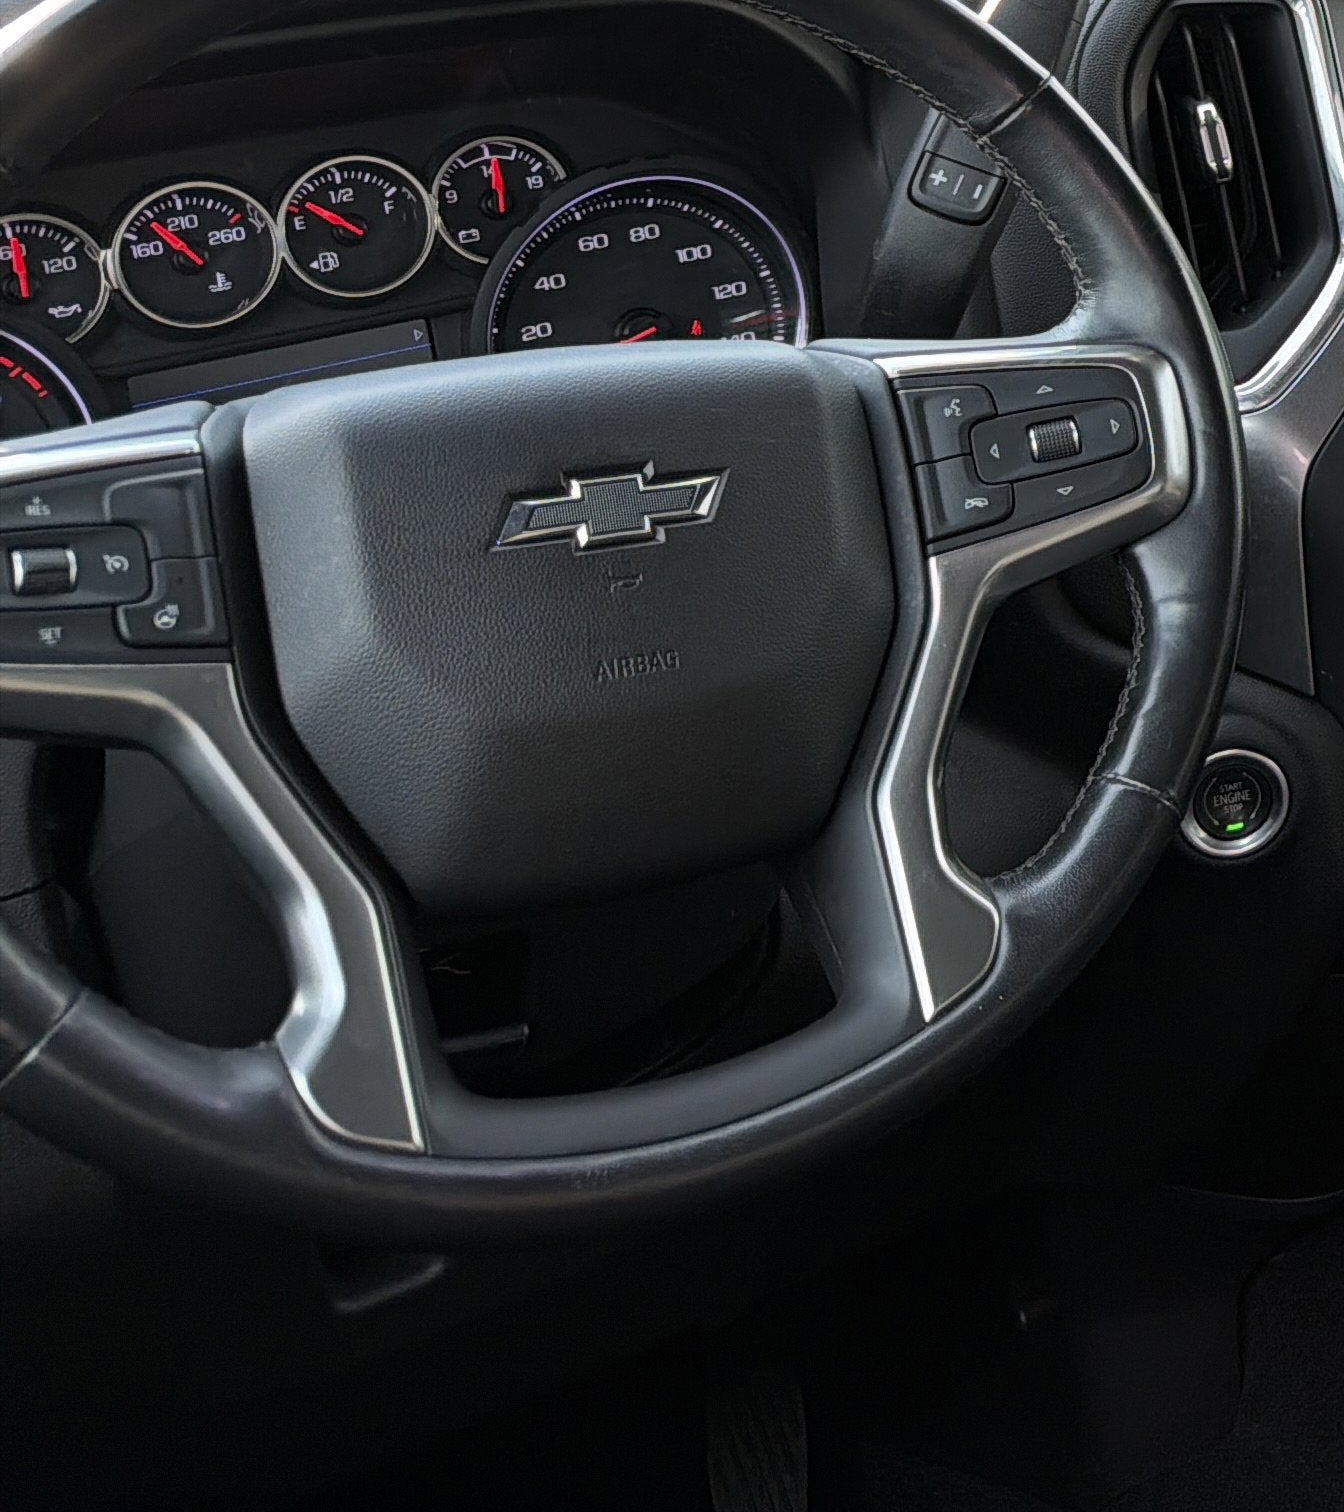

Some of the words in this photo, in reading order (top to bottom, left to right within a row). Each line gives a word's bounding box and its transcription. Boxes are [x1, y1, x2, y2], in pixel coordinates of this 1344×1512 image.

[525, 174, 544, 190] 19
[328, 188, 354, 205] 1/2
[445, 189, 458, 204] 9
[383, 200, 395, 215] F
[167, 214, 199, 232] 210
[293, 215, 306, 231] E
[208, 226, 246, 246] 260
[629, 223, 660, 243] 80
[130, 241, 164, 260] 160
[578, 233, 609, 252] 60
[675, 244, 712, 264] 100
[42, 256, 77, 274] 120
[534, 273, 566, 291] 40
[712, 281, 747, 300] 120
[521, 322, 553, 342] 20
[596, 649, 680, 682] AIRBAG
[1213, 790, 1251, 807] ENGINE
